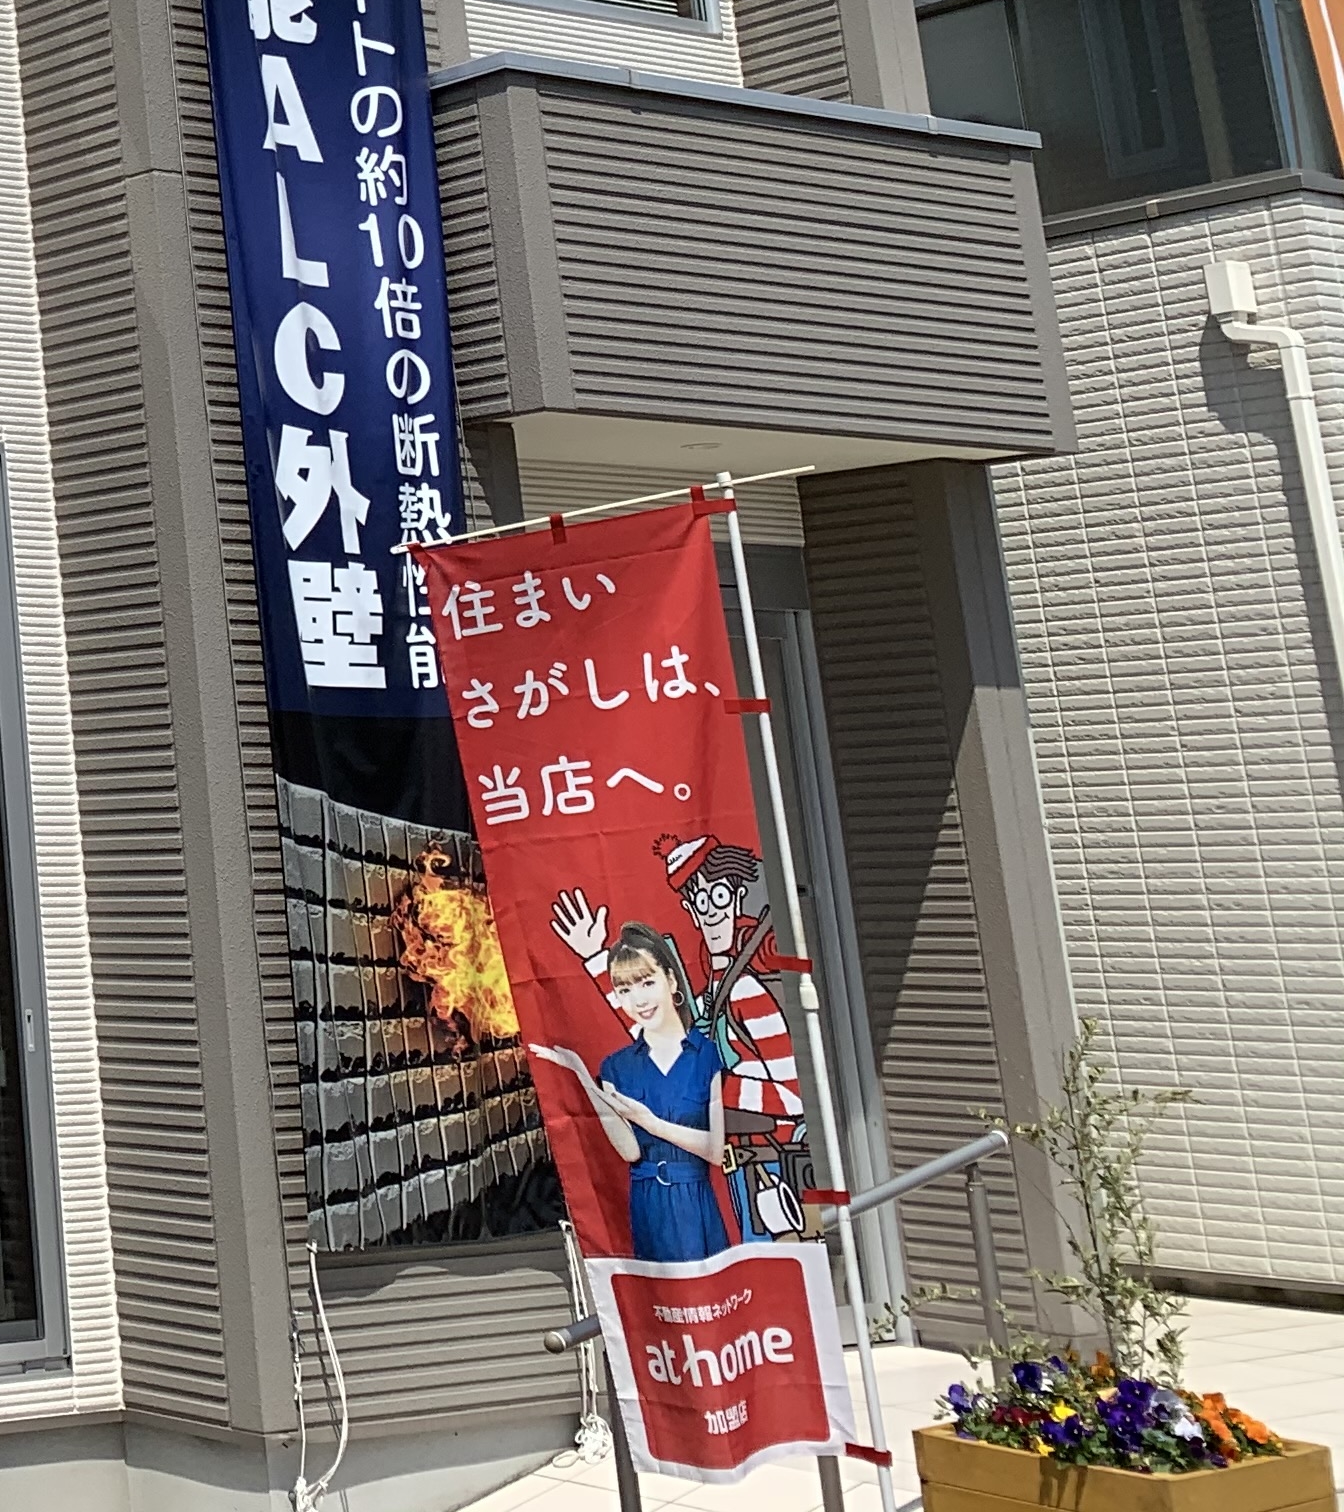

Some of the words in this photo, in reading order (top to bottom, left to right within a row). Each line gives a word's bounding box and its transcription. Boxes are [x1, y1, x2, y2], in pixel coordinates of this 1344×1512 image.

[442, 570, 617, 641] 住まい
[461, 645, 721, 729] さがしは、
[478, 755, 692, 826] 当店へ。
[652, 1288, 753, 1325] 不動産情報ネットワーク
[704, 1400, 749, 1435] 加盟店
